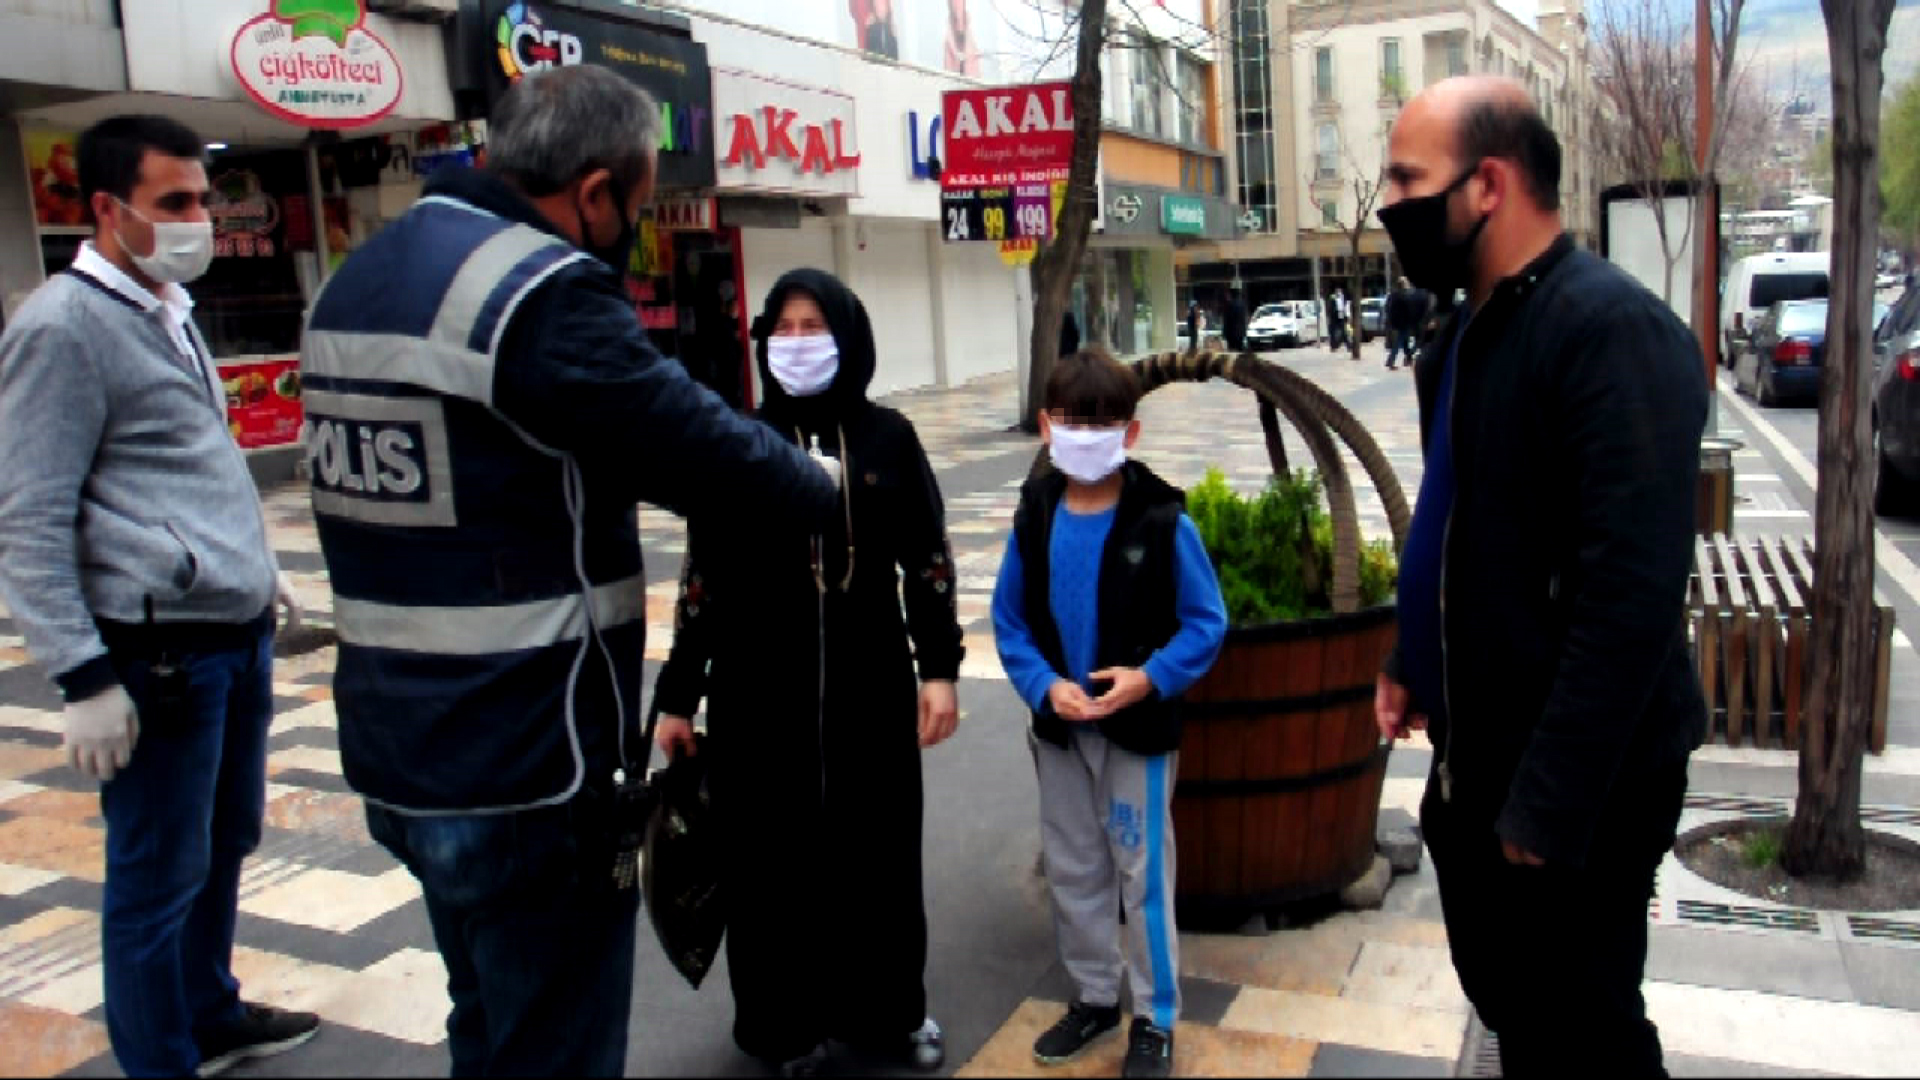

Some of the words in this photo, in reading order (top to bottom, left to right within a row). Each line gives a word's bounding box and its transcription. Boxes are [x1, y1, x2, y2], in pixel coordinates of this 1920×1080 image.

[950, 90, 1074, 139] AKAL
[726, 106, 861, 173] AKAL
[948, 207, 970, 239] 24
[983, 207, 1005, 239] 99
[1016, 204, 1047, 236] 199
